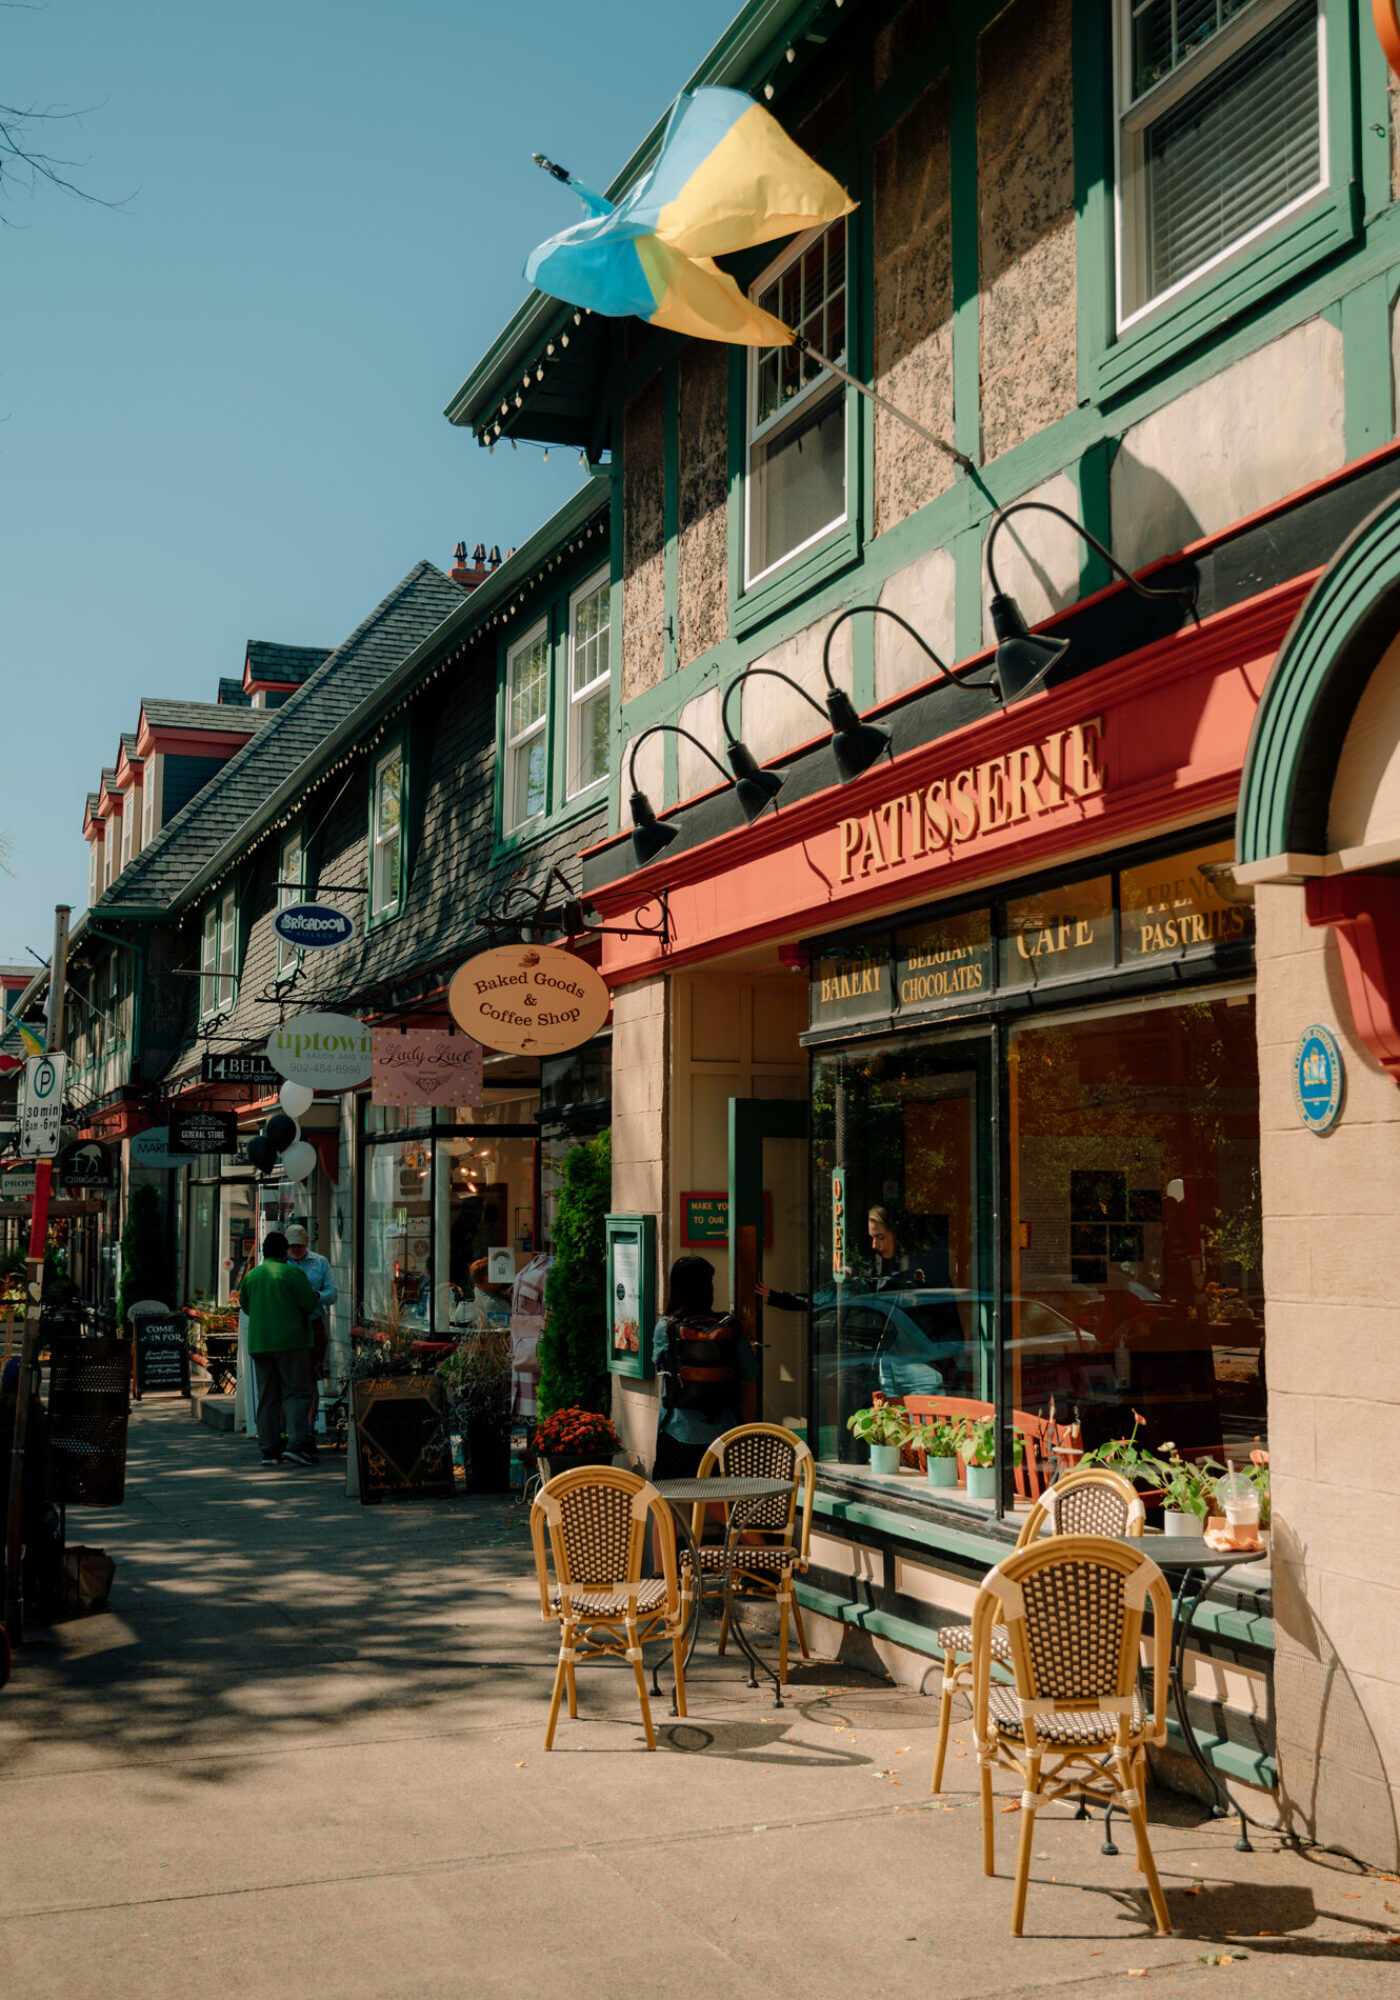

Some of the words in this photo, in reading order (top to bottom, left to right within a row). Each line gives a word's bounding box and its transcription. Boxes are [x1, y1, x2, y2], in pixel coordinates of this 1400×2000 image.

[837, 716, 1107, 882] PATISSERIE
[280, 914, 346, 933] BRIGADOON
[1140, 906, 1244, 953] PASTRIES
[1016, 914, 1094, 959] CAFE
[908, 942, 974, 971] BELGIAN
[473, 972, 528, 995] Baked
[534, 972, 586, 999] Goods
[820, 957, 881, 1002] BAKERY
[901, 963, 983, 1003] CHOCOLATES
[523, 993, 538, 1007] &
[479, 1002, 533, 1026] Coffee
[537, 1006, 581, 1026] Shop
[276, 1031, 373, 1058] uptown
[379, 1043, 426, 1068] Lady
[427, 1043, 475, 1070] Luck
[207, 1057, 227, 1080] 14
[229, 1058, 278, 1074] BELL
[26, 1107, 38, 1118] 30
[40, 1105, 59, 1117] min
[181, 1130, 206, 1139] GENERAL
[207, 1130, 225, 1139] STORE
[691, 1202, 713, 1211] MAKE
[694, 1216, 704, 1224] TO
[708, 1216, 725, 1224] OUR
[832, 1178, 844, 1274] OPEN
[146, 1325, 174, 1334] COME
[151, 1333, 161, 1342] IN
[162, 1333, 185, 1342] FOR
